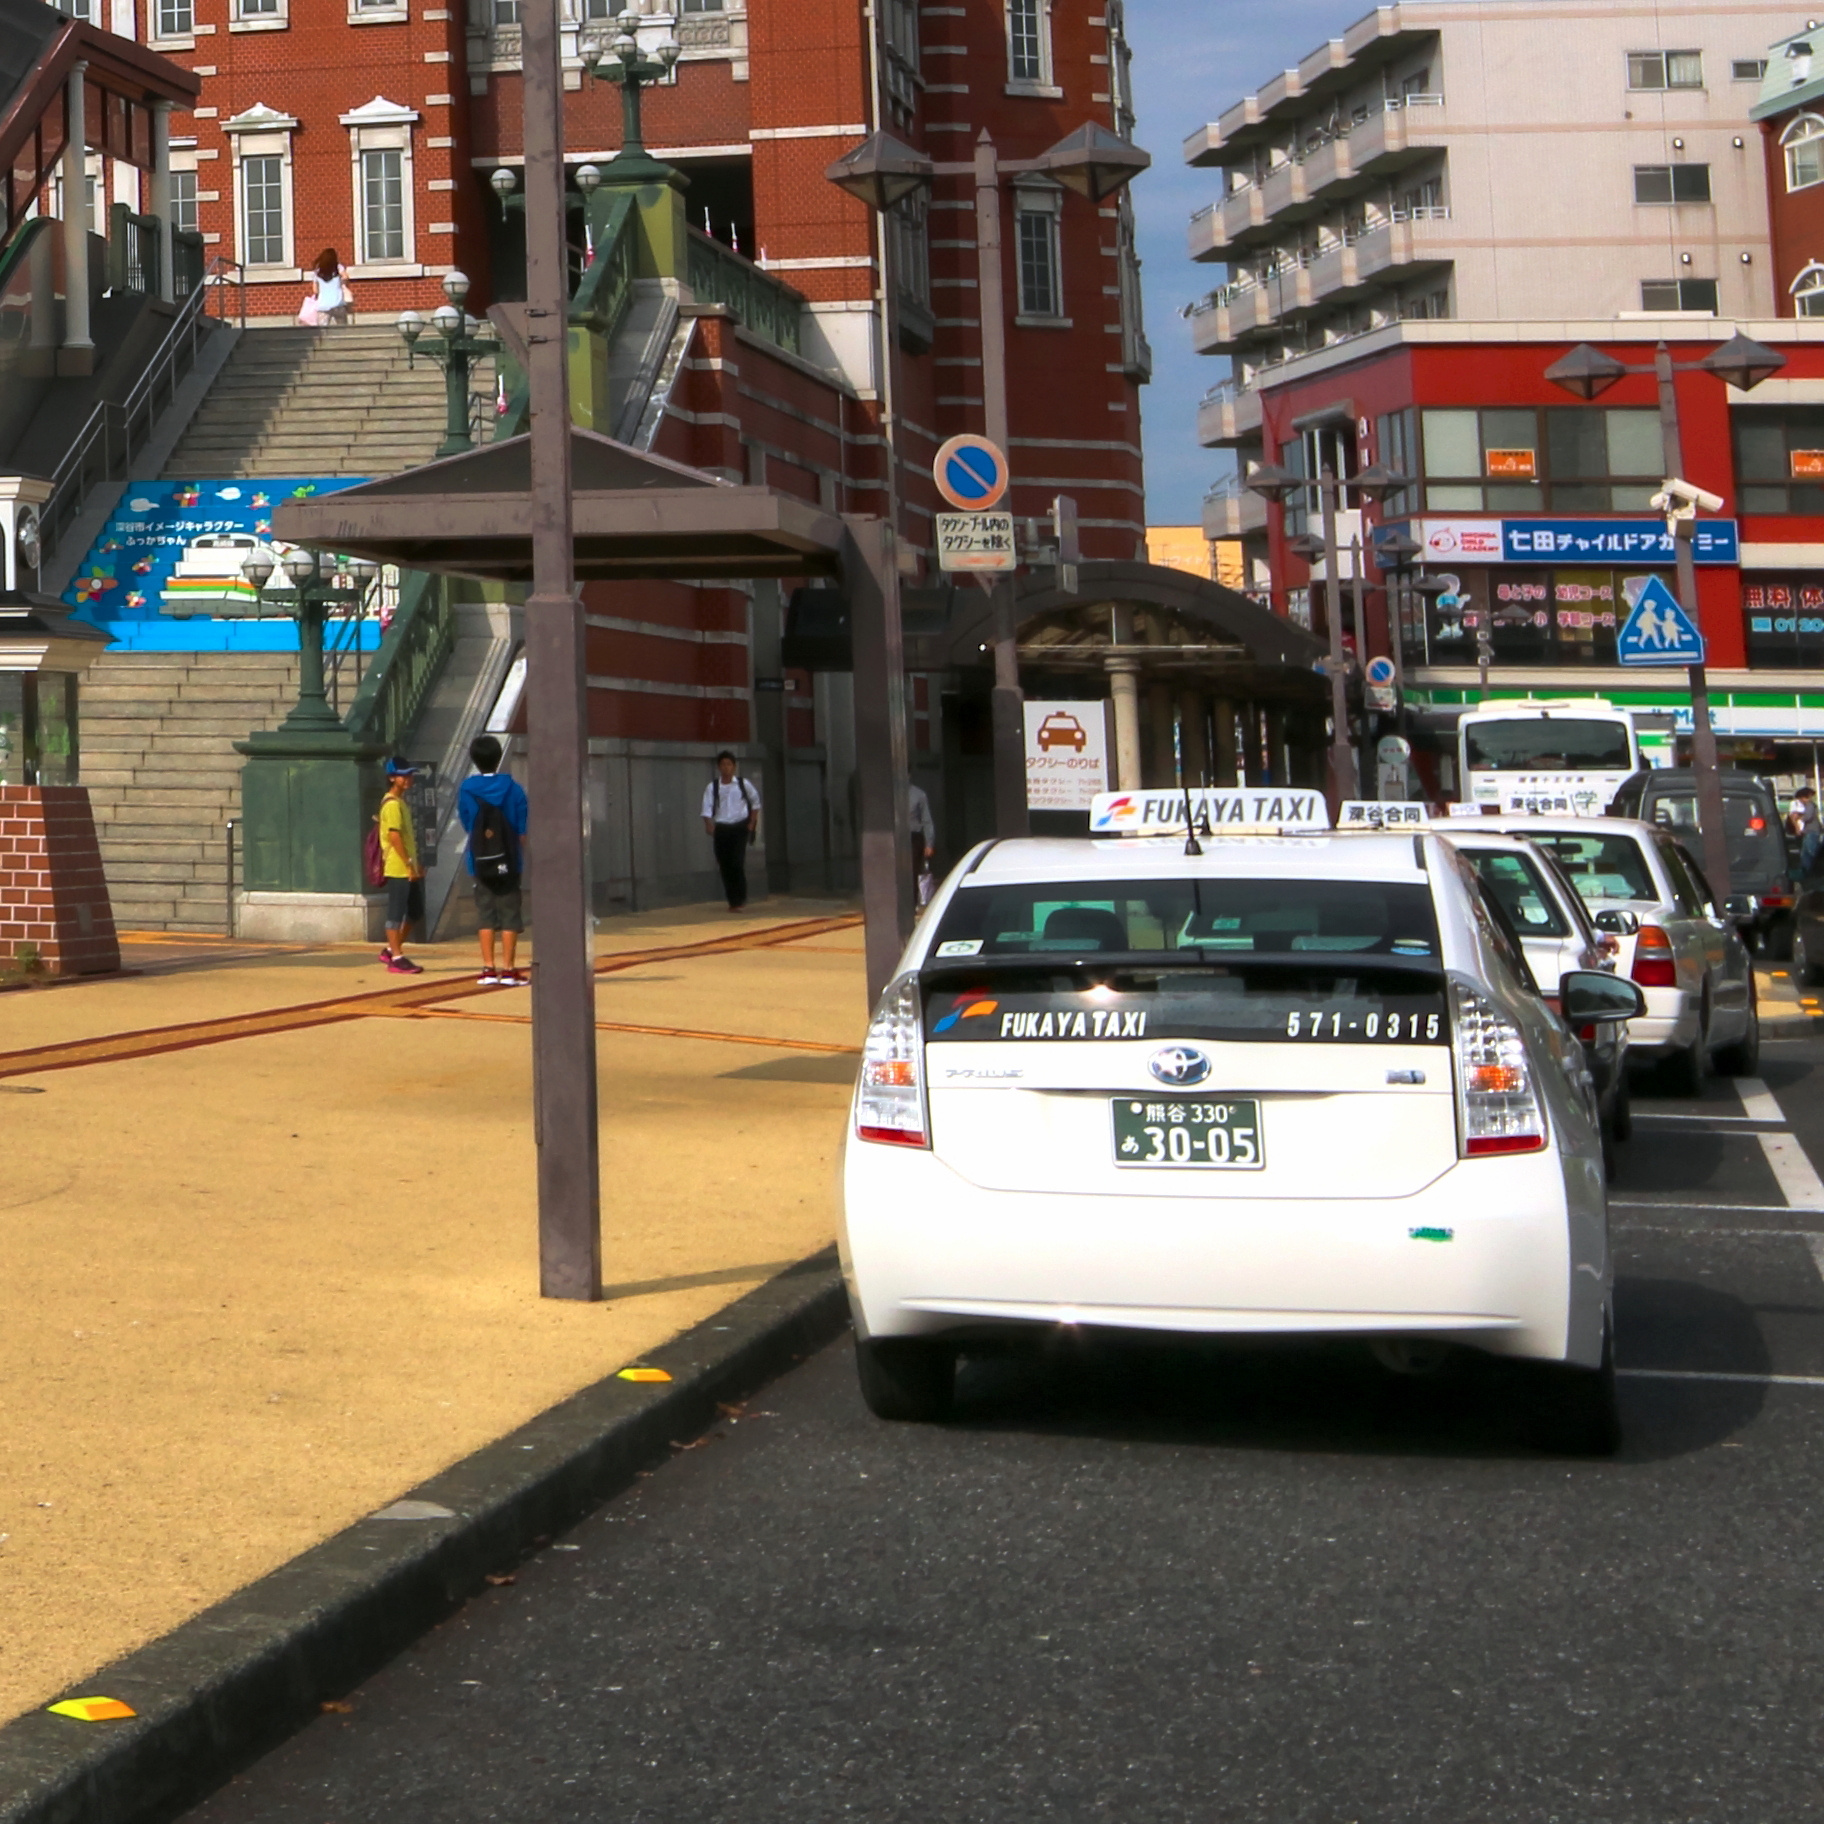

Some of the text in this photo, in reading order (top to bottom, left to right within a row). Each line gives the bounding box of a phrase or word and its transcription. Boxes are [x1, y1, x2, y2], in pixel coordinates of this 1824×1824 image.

[115, 520, 245, 533] 深谷市イメージキャラクター
[125, 535, 188, 547] ふっかちゃん
[943, 535, 1012, 550] タクシーを除く
[1509, 530, 1728, 551] 七田チャイルドアカミー
[1026, 757, 1099, 769] タクシーのりば
[1142, 796, 1315, 824] FUKAYA TAXI
[1510, 796, 1568, 811] 深谷合同
[1348, 805, 1420, 823] 深谷合同
[1000, 1010, 1147, 1037] FUKAYA TAXI
[1287, 1011, 1440, 1039] 571-0315
[1145, 1103, 1228, 1124] 熊谷 330
[1121, 1126, 1256, 1163] あ 30-05
